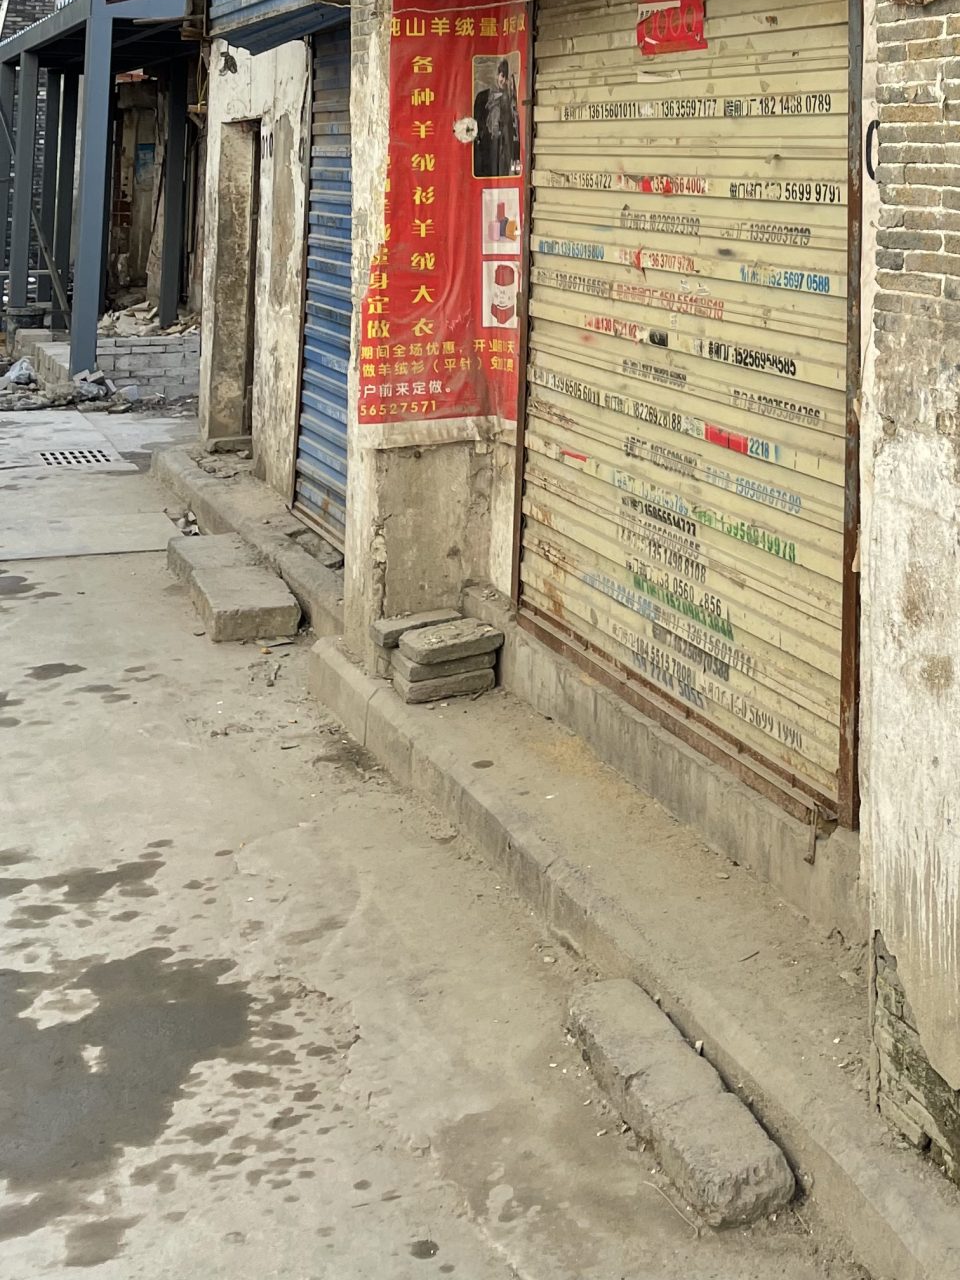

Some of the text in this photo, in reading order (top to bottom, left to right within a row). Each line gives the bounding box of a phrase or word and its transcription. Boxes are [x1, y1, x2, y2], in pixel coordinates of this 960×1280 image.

[806, 93, 831, 112] 0789
[785, 183, 811, 200] 5699
[360, 400, 436, 416] 56527571
[750, 438, 769, 459] 2218
